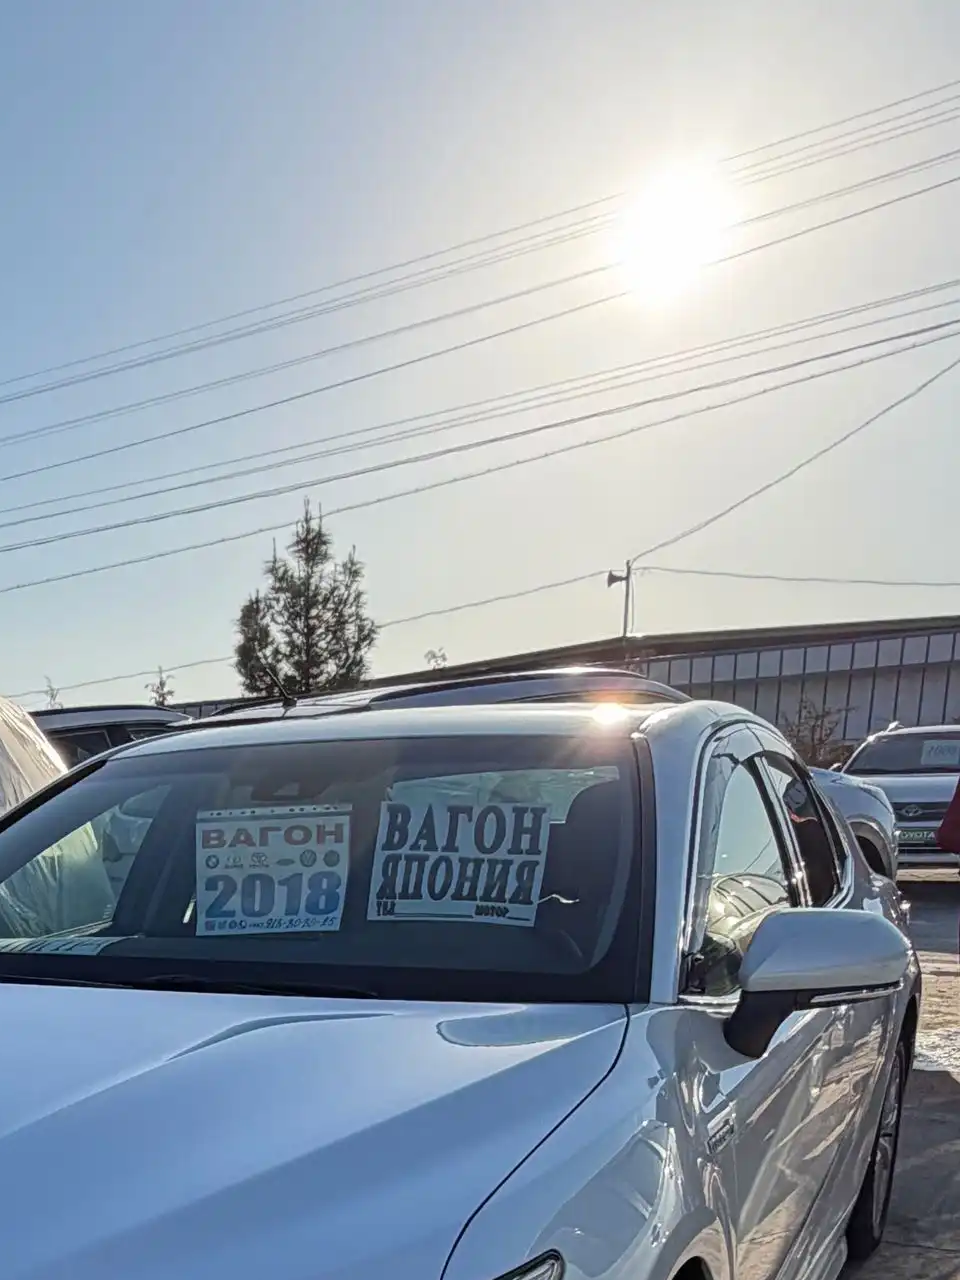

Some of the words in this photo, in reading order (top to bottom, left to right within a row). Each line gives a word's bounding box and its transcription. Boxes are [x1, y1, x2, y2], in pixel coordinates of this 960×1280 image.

[201, 823, 345, 849] ВАГОН
[381, 803, 547, 855] ВАГОН
[895, 831, 936, 841] OYOTA
[205, 871, 342, 919] 2018
[375, 853, 540, 905] ЯПОНИЯ
